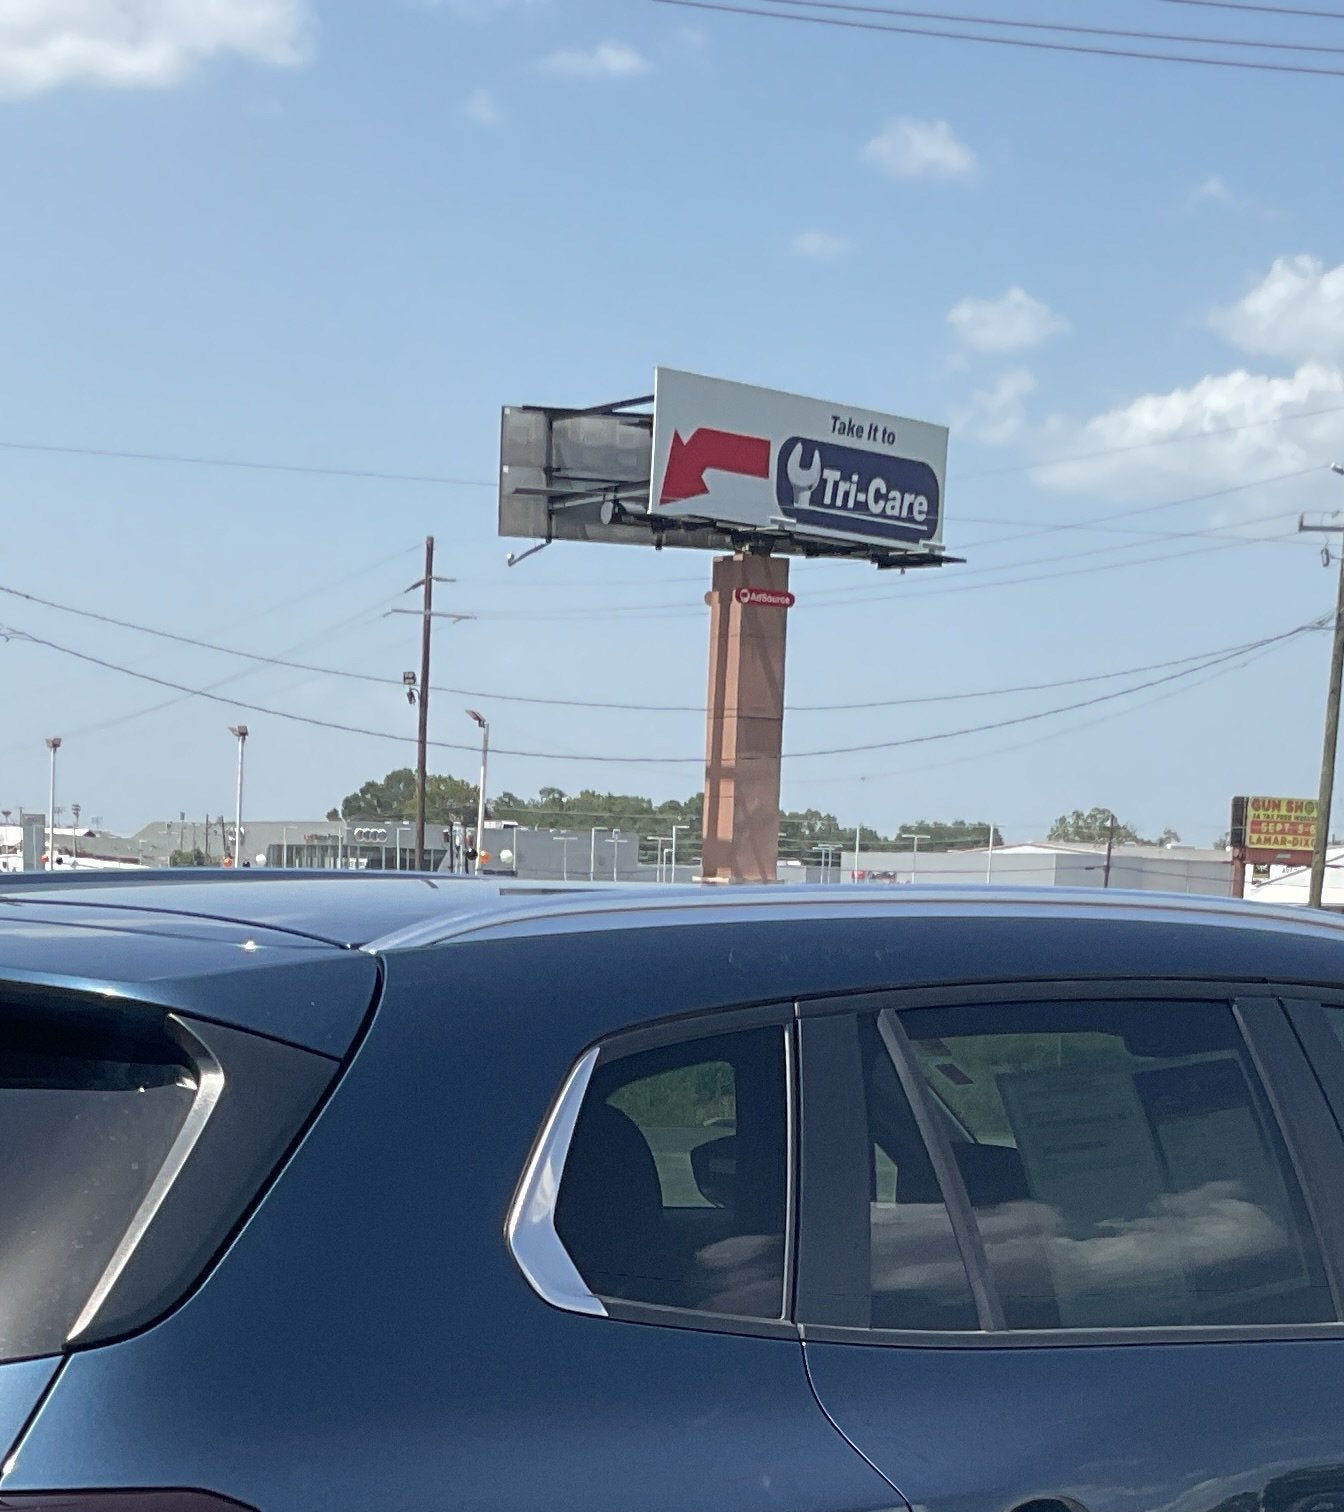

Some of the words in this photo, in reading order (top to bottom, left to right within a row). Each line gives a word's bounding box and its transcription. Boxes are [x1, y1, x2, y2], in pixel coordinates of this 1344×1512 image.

[831, 415, 864, 439] Take
[867, 423, 879, 441] It
[882, 427, 895, 446] to
[822, 468, 929, 522] Tri-Care
[1250, 798, 1281, 813] GUN
[1285, 799, 1318, 815] SHO
[1261, 823, 1290, 834] SEPT
